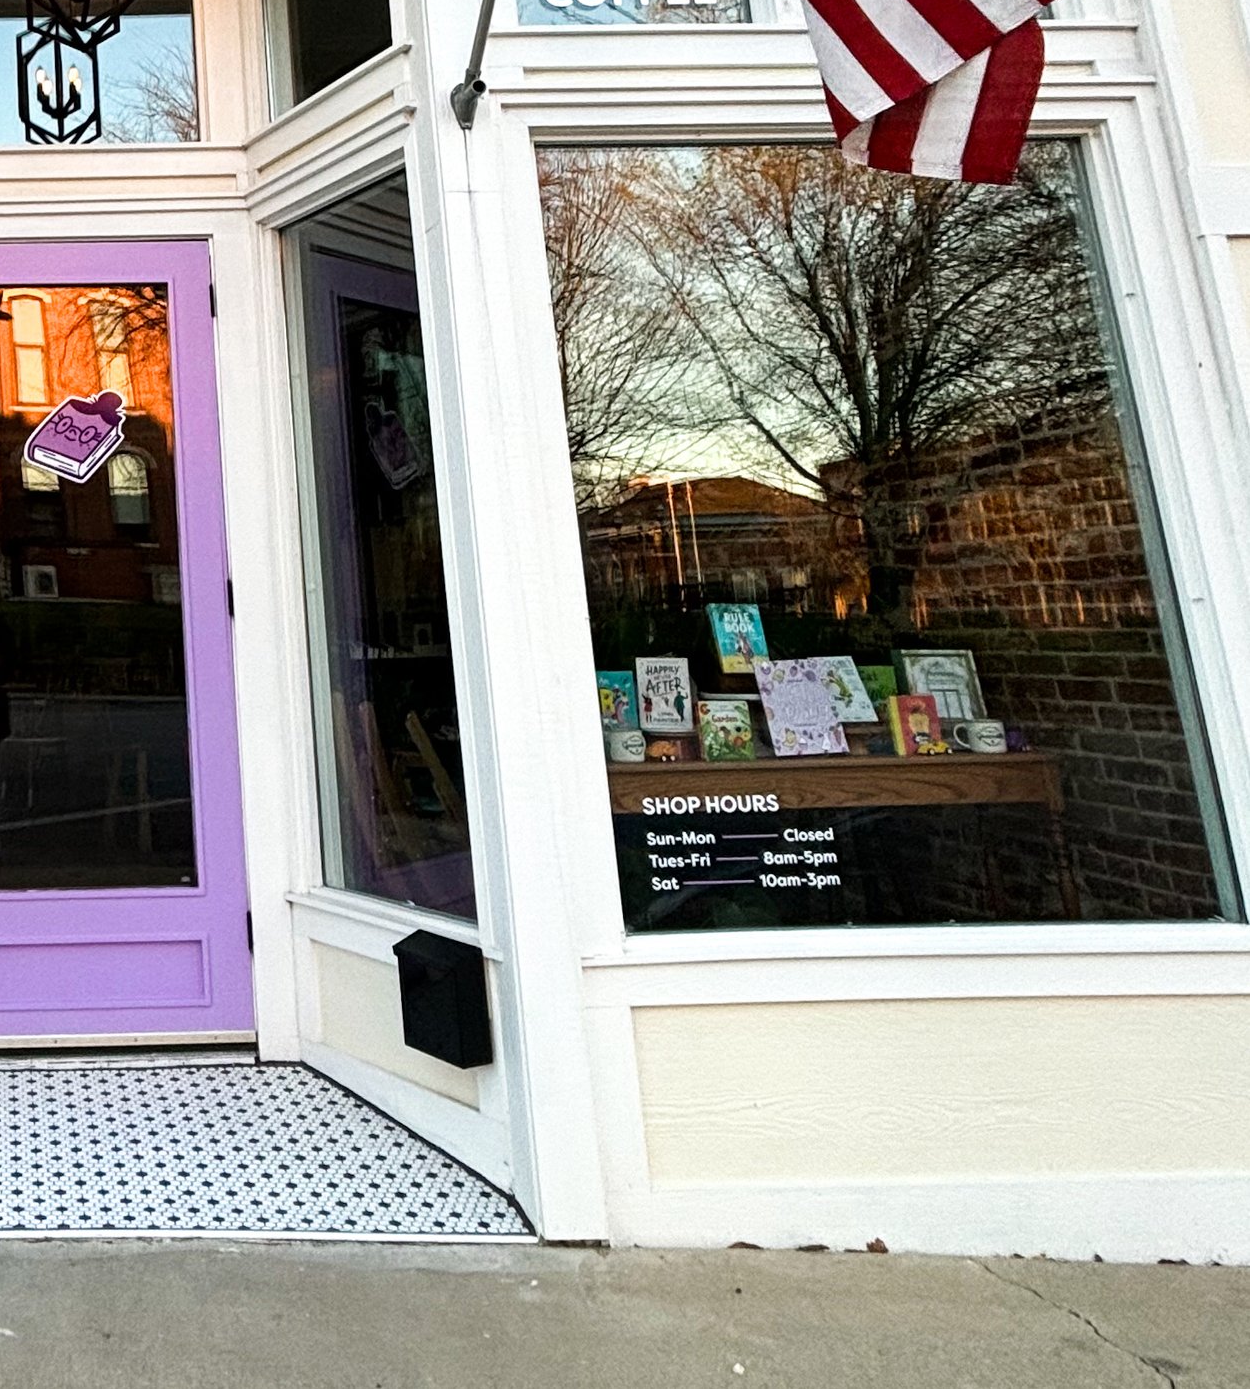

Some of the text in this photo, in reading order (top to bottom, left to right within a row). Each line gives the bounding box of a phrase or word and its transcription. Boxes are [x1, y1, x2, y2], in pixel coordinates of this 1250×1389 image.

[723, 612, 751, 622] RULE
[724, 622, 756, 632] BOOK
[646, 677, 685, 694] AFTER
[641, 794, 780, 816] SHOP HOURS
[646, 827, 835, 846] Sun-Mon Closed
[648, 851, 838, 868] Tues-Fri 8am-5pm
[651, 873, 841, 891] Sat 10am-3pm
